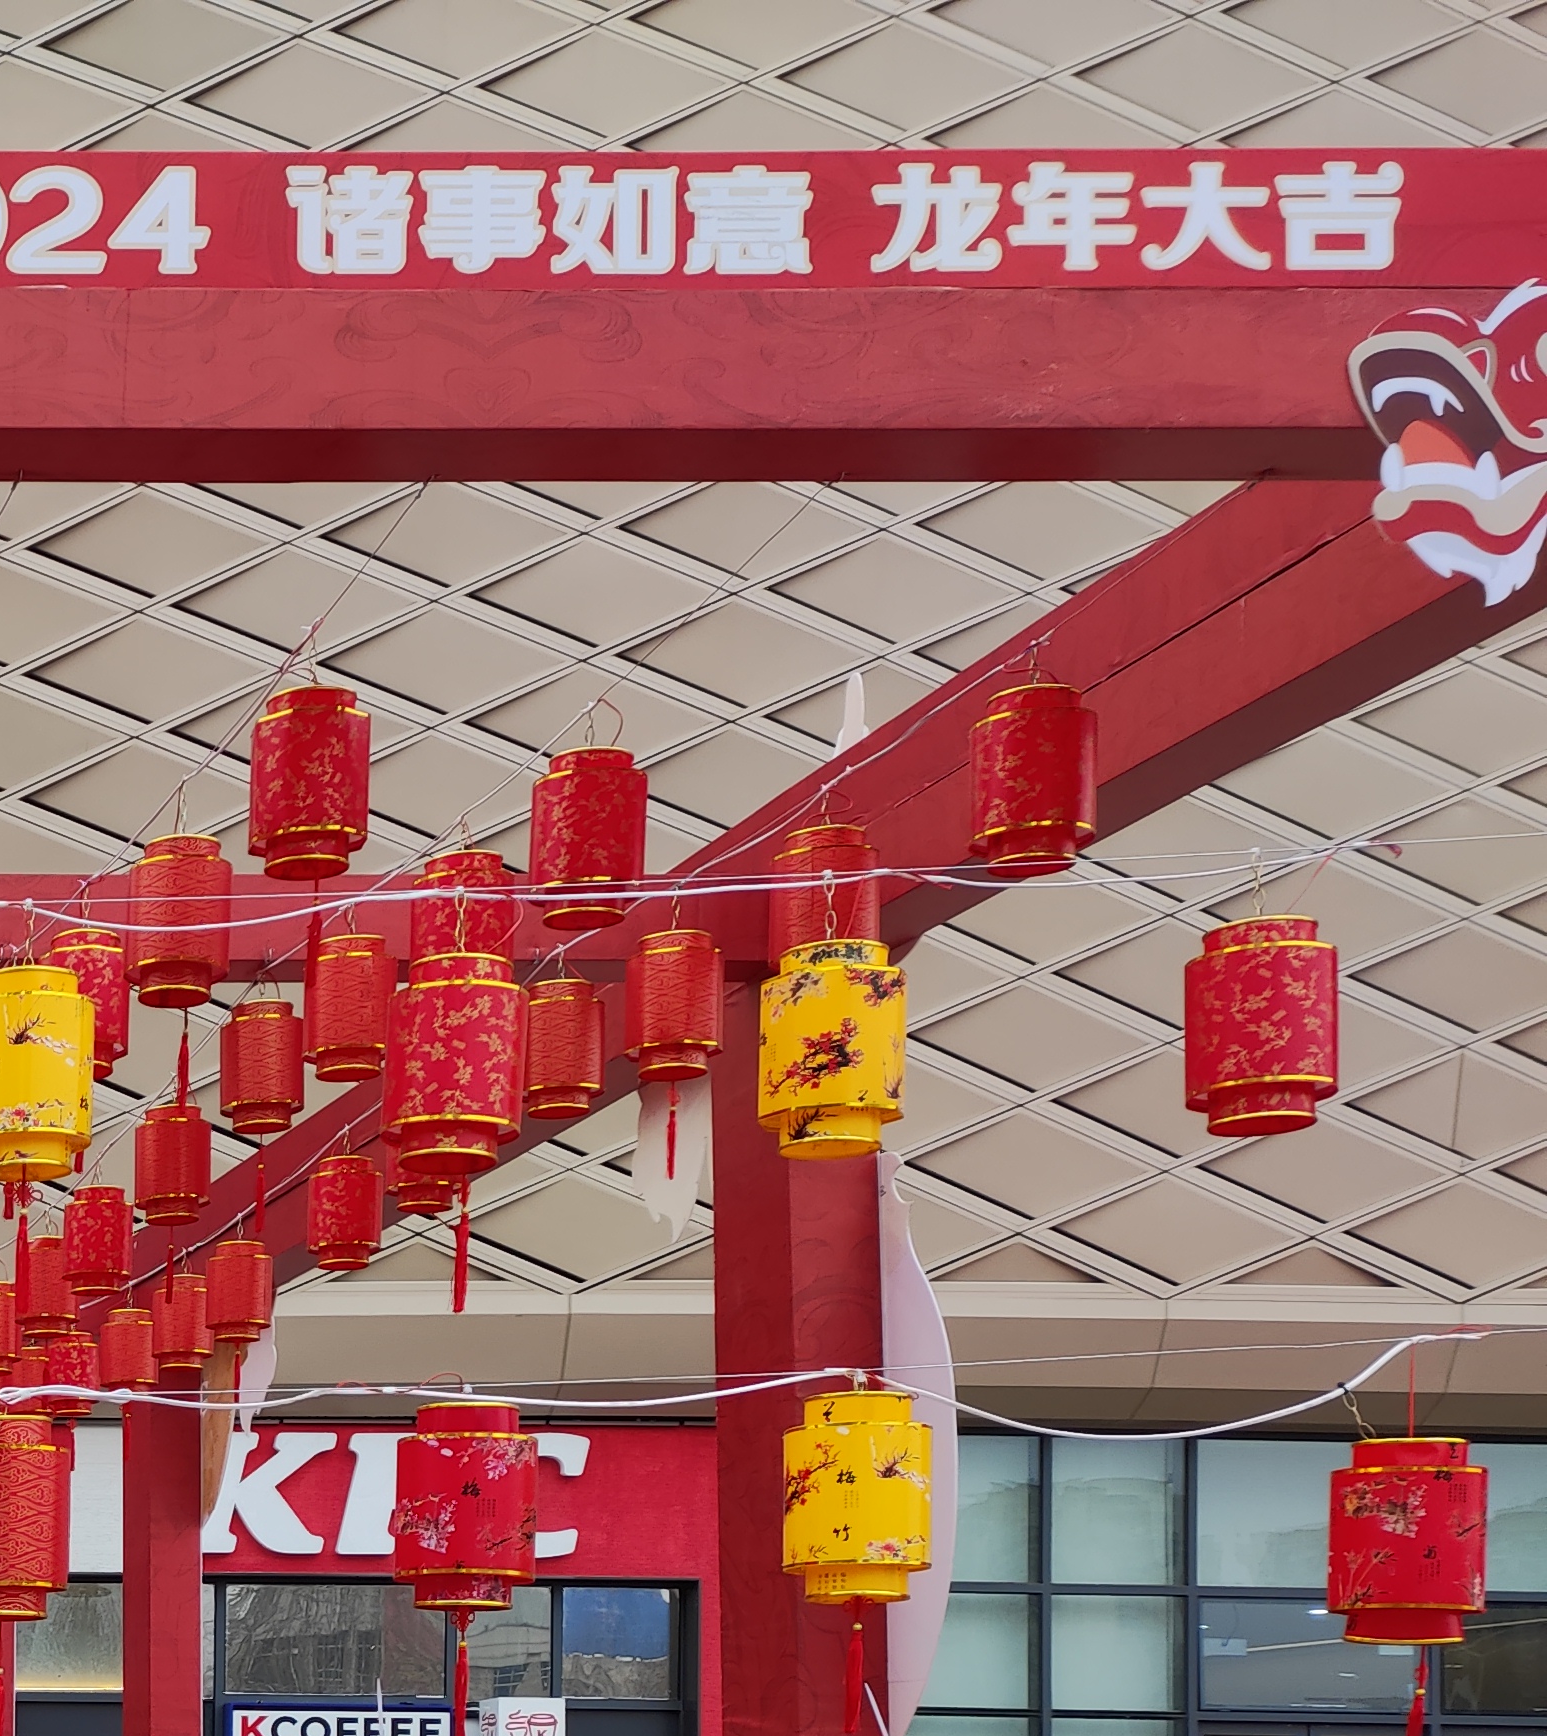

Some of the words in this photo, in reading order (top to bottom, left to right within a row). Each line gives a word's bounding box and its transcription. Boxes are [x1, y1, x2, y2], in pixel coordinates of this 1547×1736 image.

[285, 165, 814, 276] 诸事如意
[870, 161, 1404, 273] 龙年大吉
[836, 1466, 856, 1485] 梅
[1433, 1469, 1454, 1481] 梅
[461, 1478, 481, 1498] 梅
[833, 1523, 852, 1541] 竹
